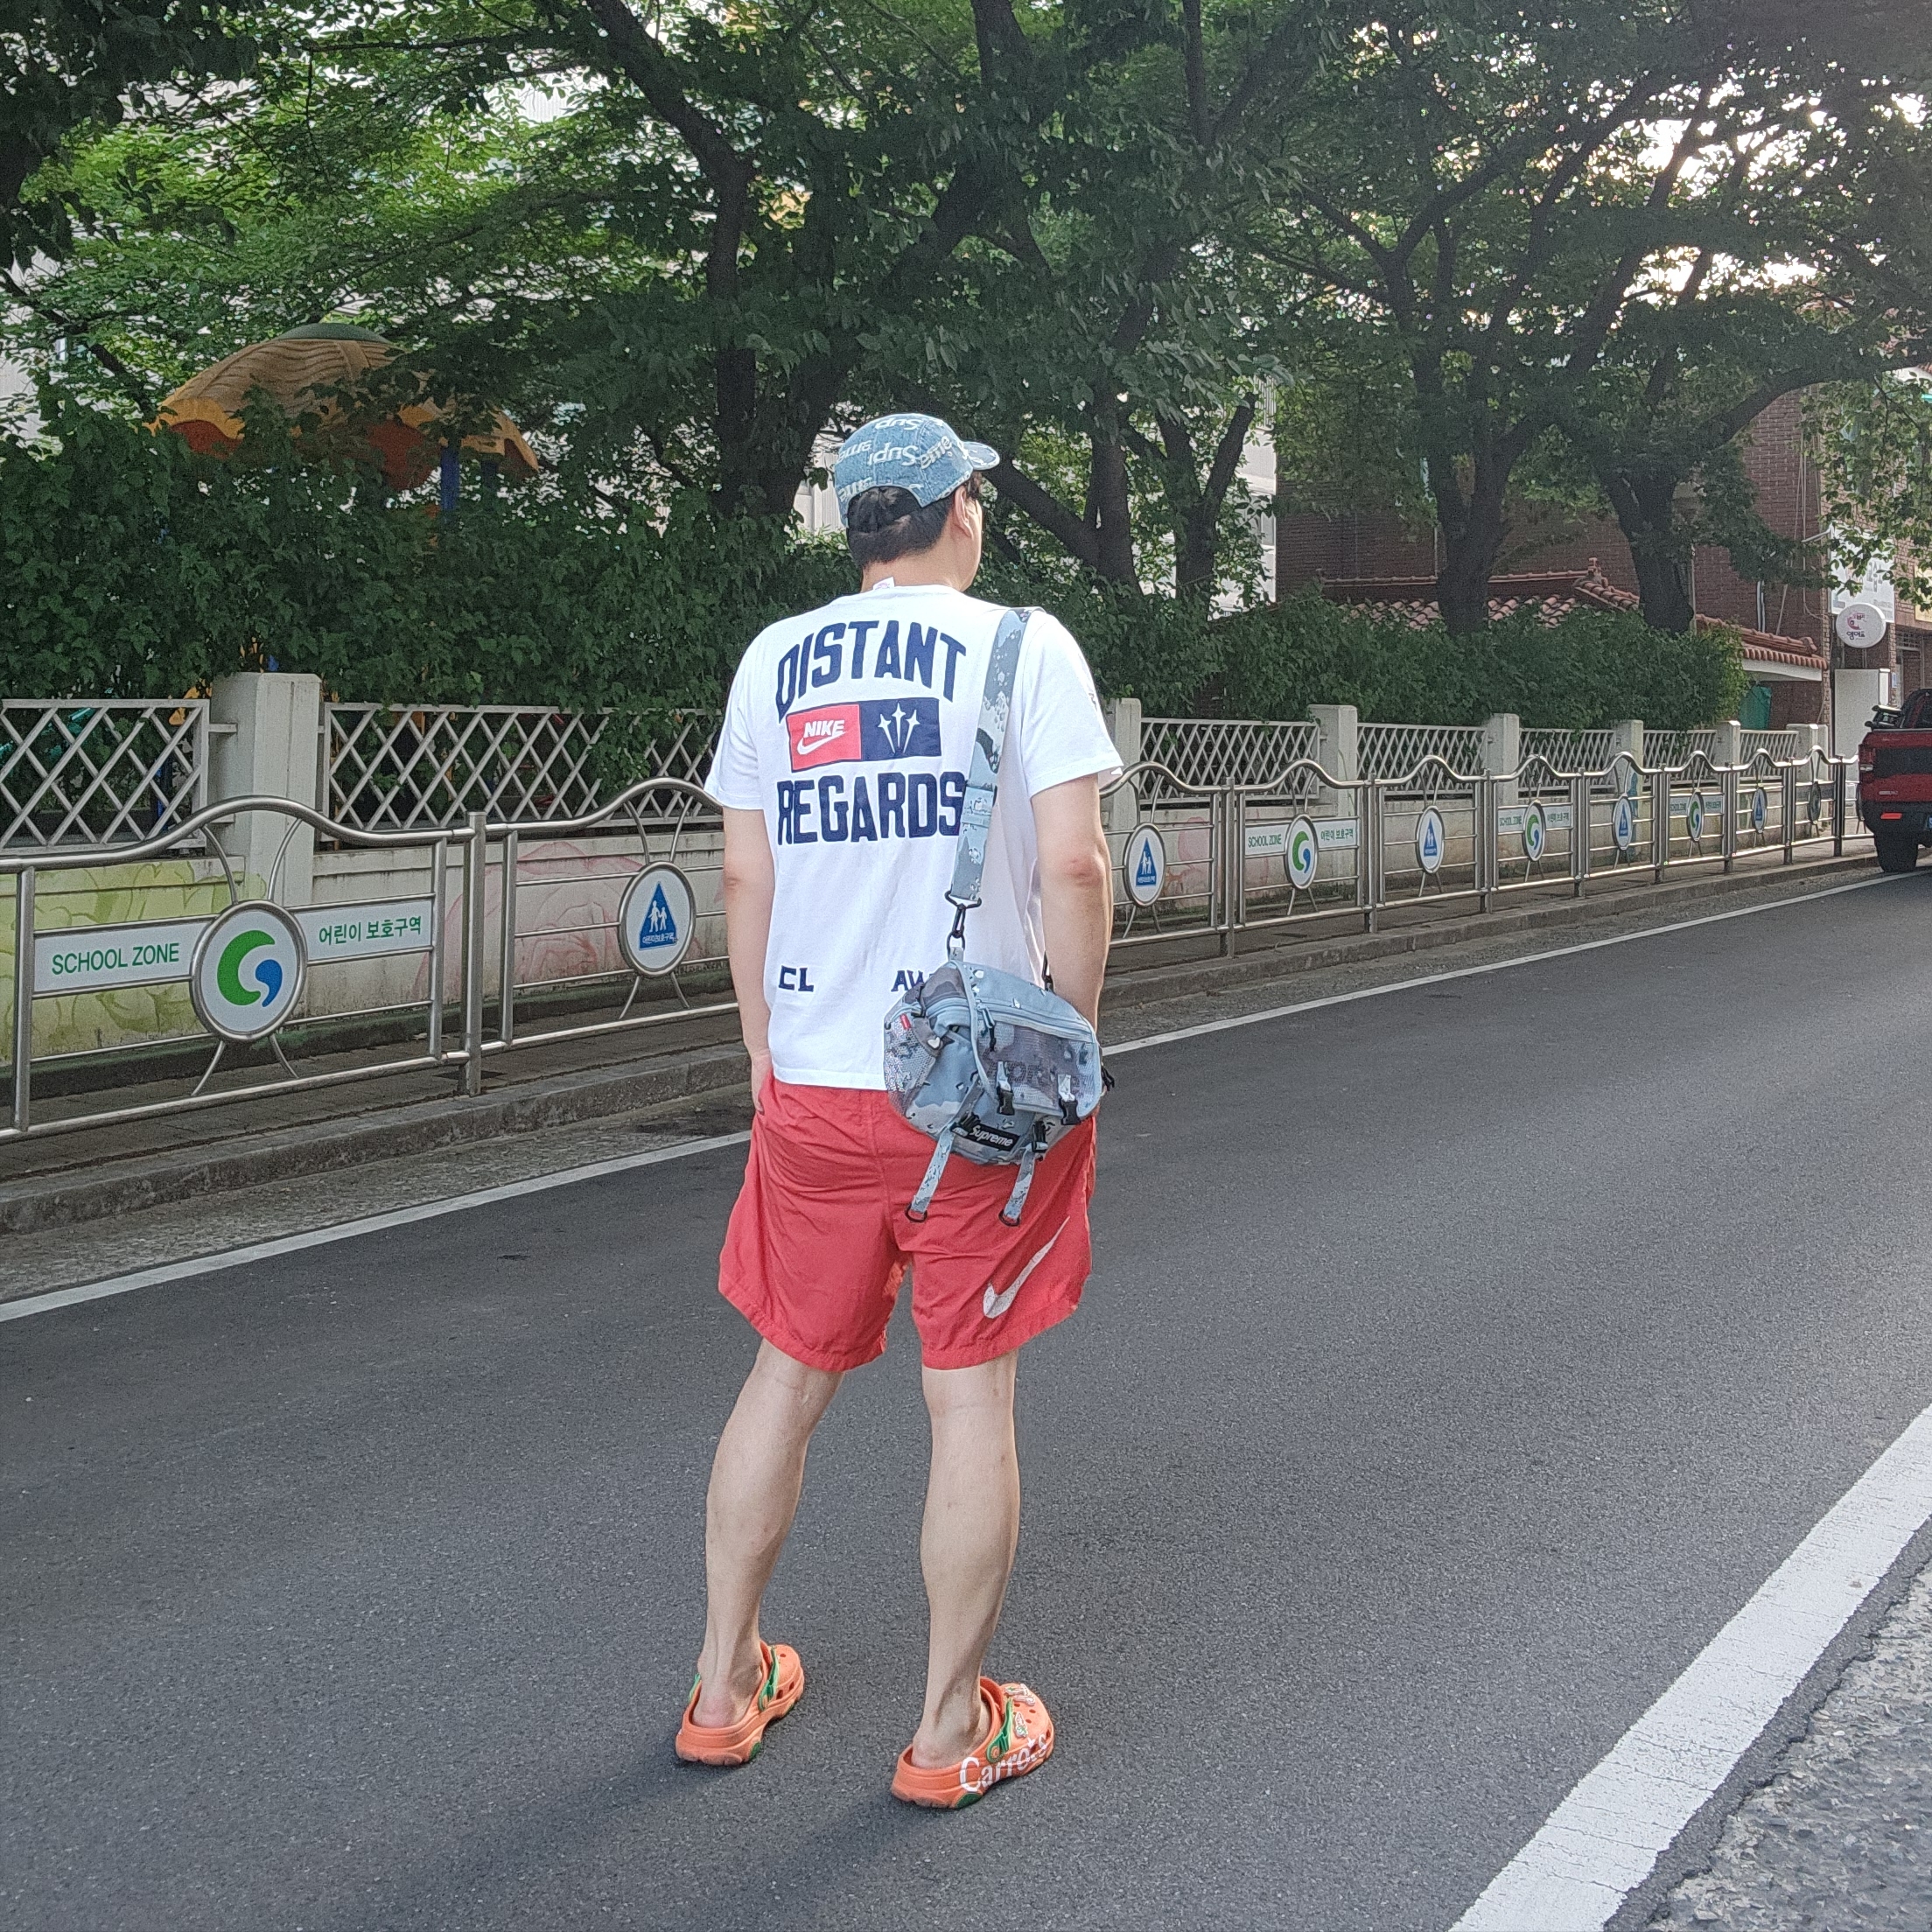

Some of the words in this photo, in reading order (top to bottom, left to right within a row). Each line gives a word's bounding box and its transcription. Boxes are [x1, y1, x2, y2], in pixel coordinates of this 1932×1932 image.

[775, 620, 967, 724] DISTANT
[803, 719, 845, 738] NIKE
[777, 771, 969, 845] REGARDS
[318, 921, 361, 946] 어린이
[366, 915, 422, 939] 보호구역
[52, 948, 129, 975] SCHOOL
[131, 942, 180, 966] ZONE
[969, 1124, 1014, 1147] Supreme
